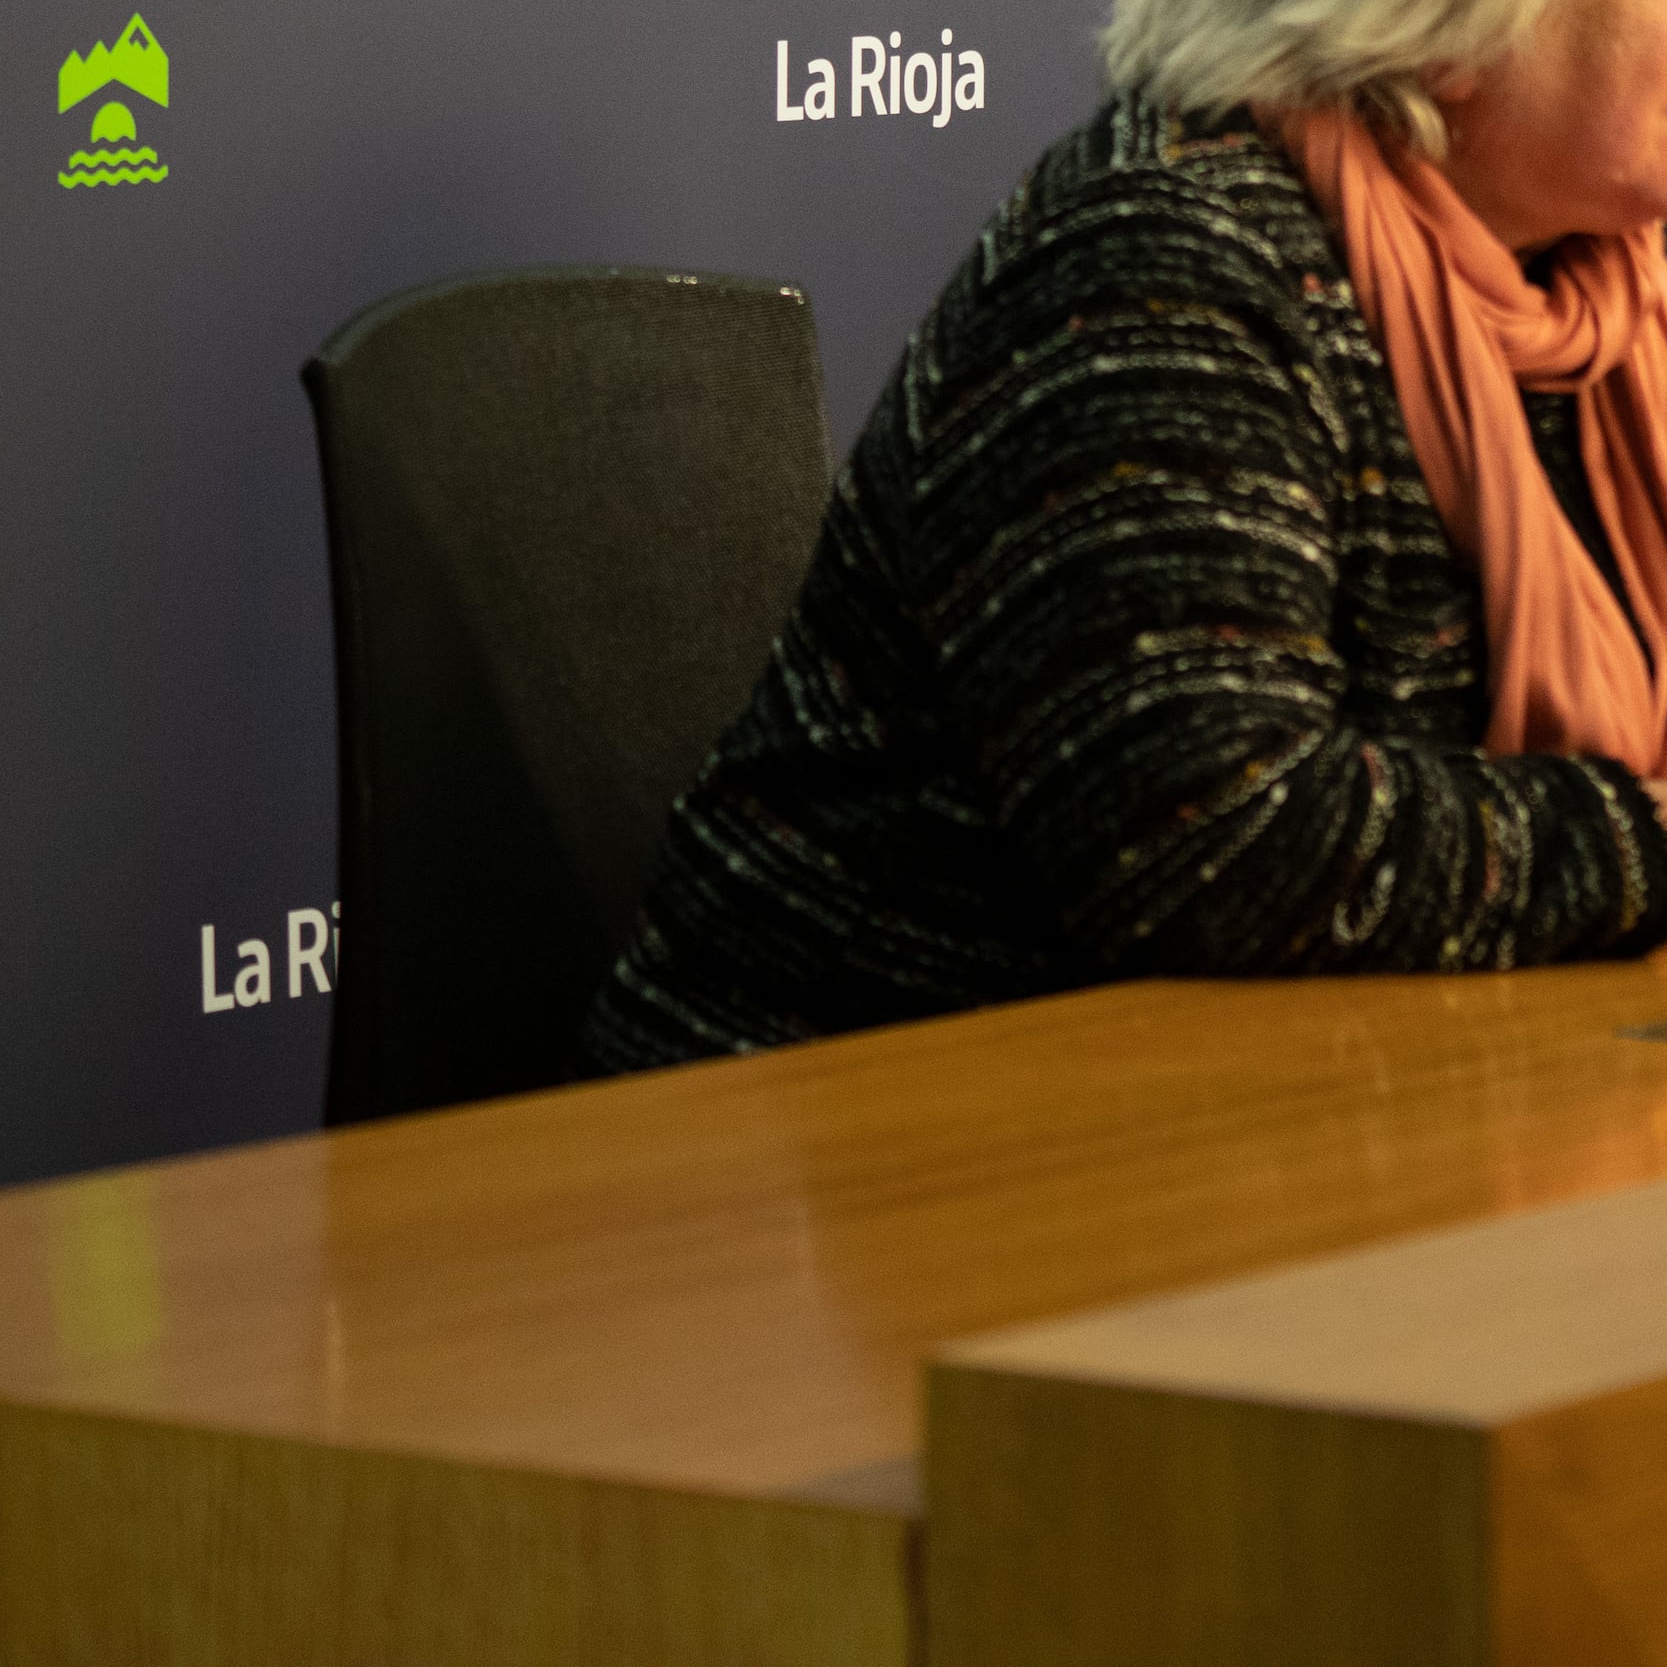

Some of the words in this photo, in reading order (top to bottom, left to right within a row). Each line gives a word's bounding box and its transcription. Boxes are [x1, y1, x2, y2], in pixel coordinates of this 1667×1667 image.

[775, 38, 836, 122] La
[849, 26, 986, 129] Rioja
[201, 922, 272, 1014] La
